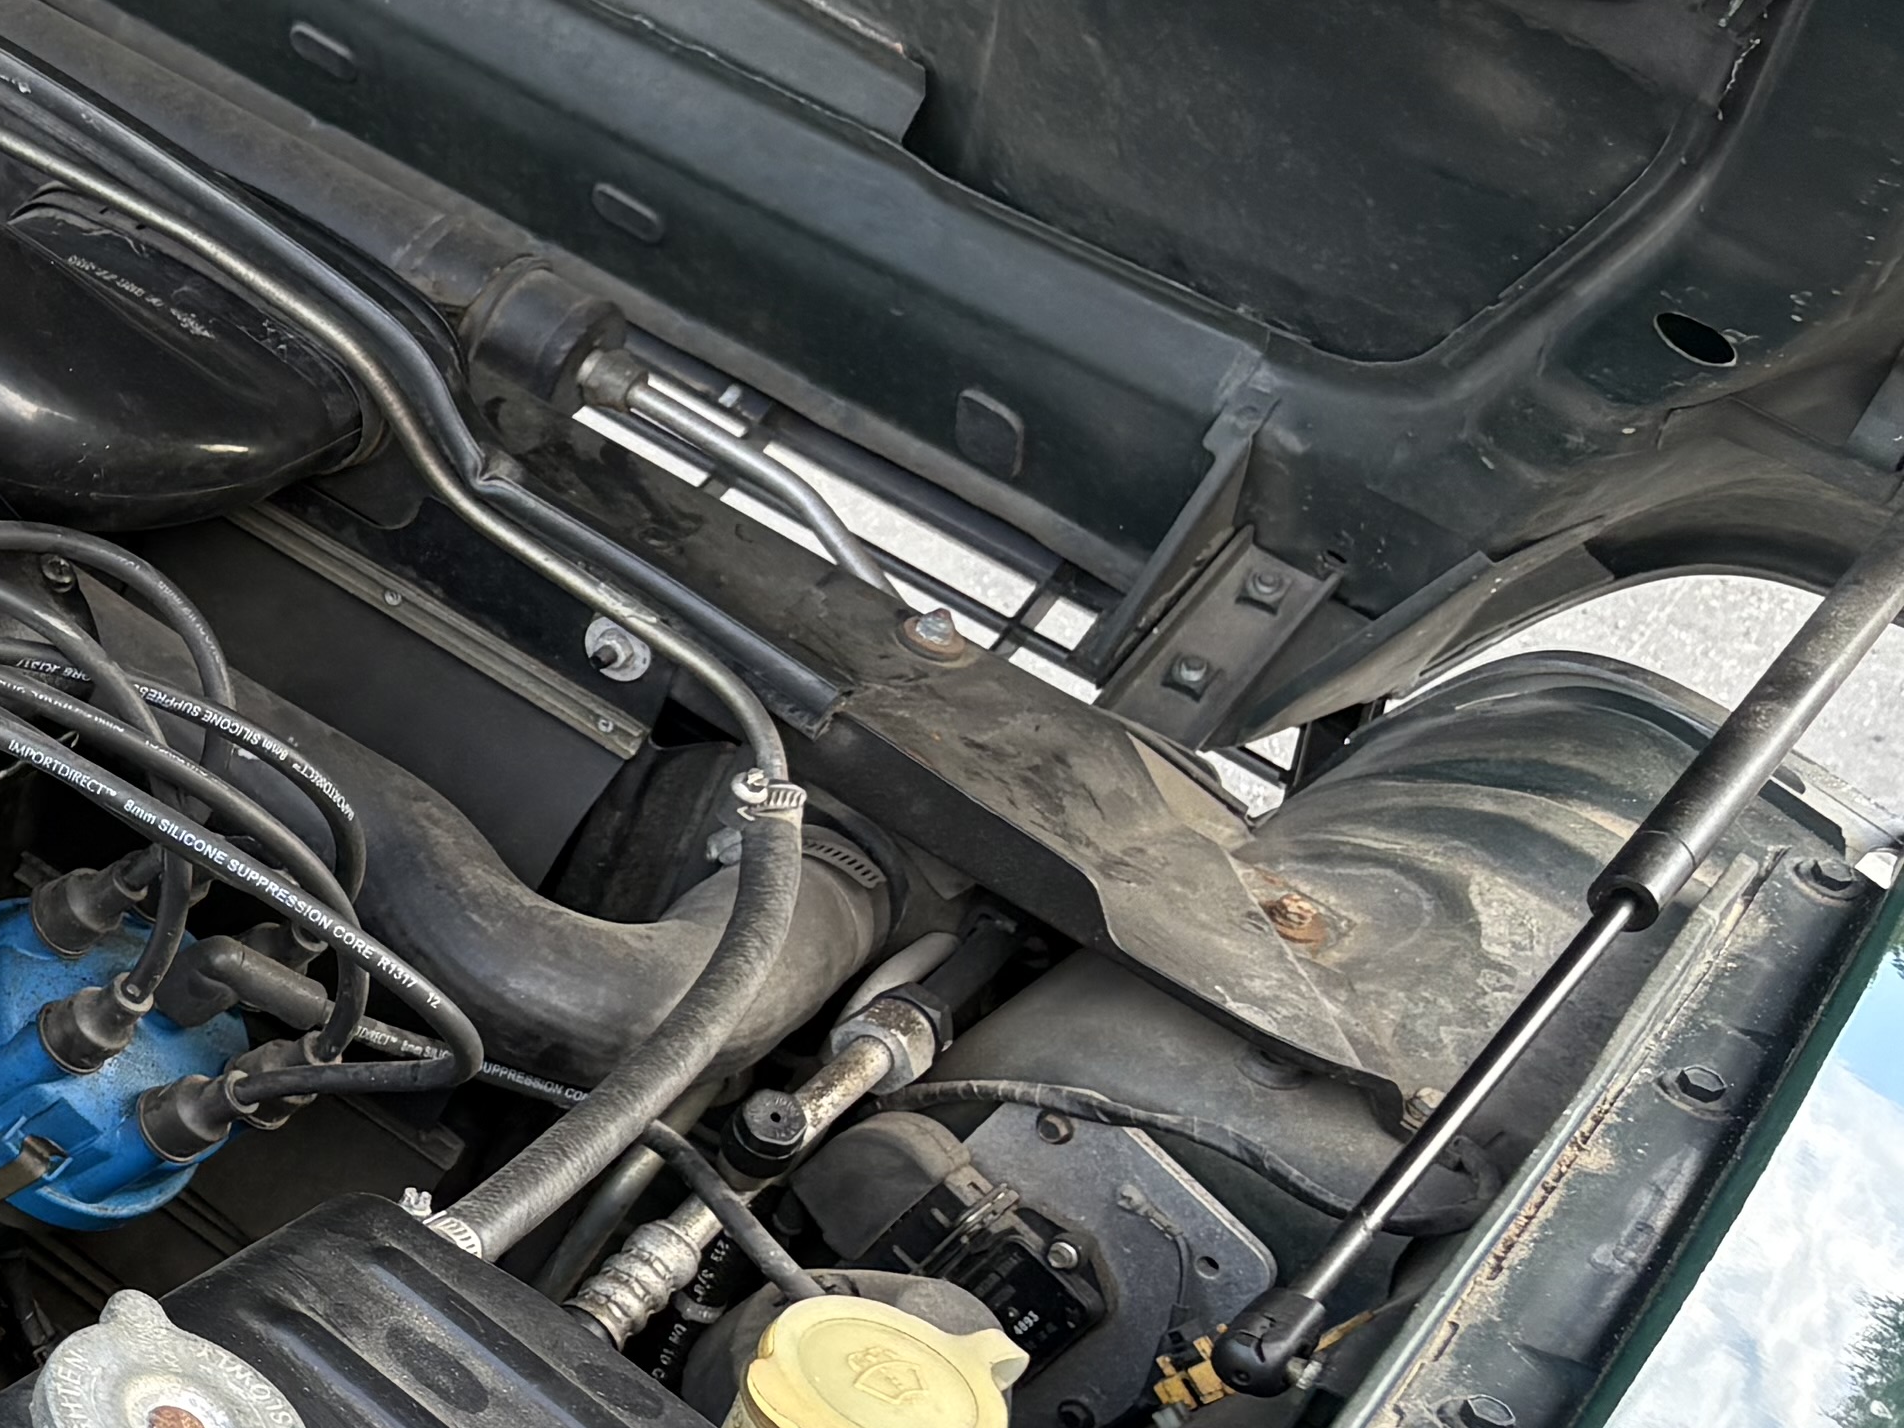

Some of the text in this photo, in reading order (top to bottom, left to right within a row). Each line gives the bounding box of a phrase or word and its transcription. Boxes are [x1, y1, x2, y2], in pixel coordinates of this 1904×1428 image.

[202, 709, 261, 745] SILICONE
[123, 798, 157, 826] 8mm
[157, 817, 228, 865] SILICONE
[226, 858, 334, 931] SUPPRESSION
[332, 924, 375, 960] CORE
[376, 954, 419, 989] R1317
[424, 990, 442, 1010] 12
